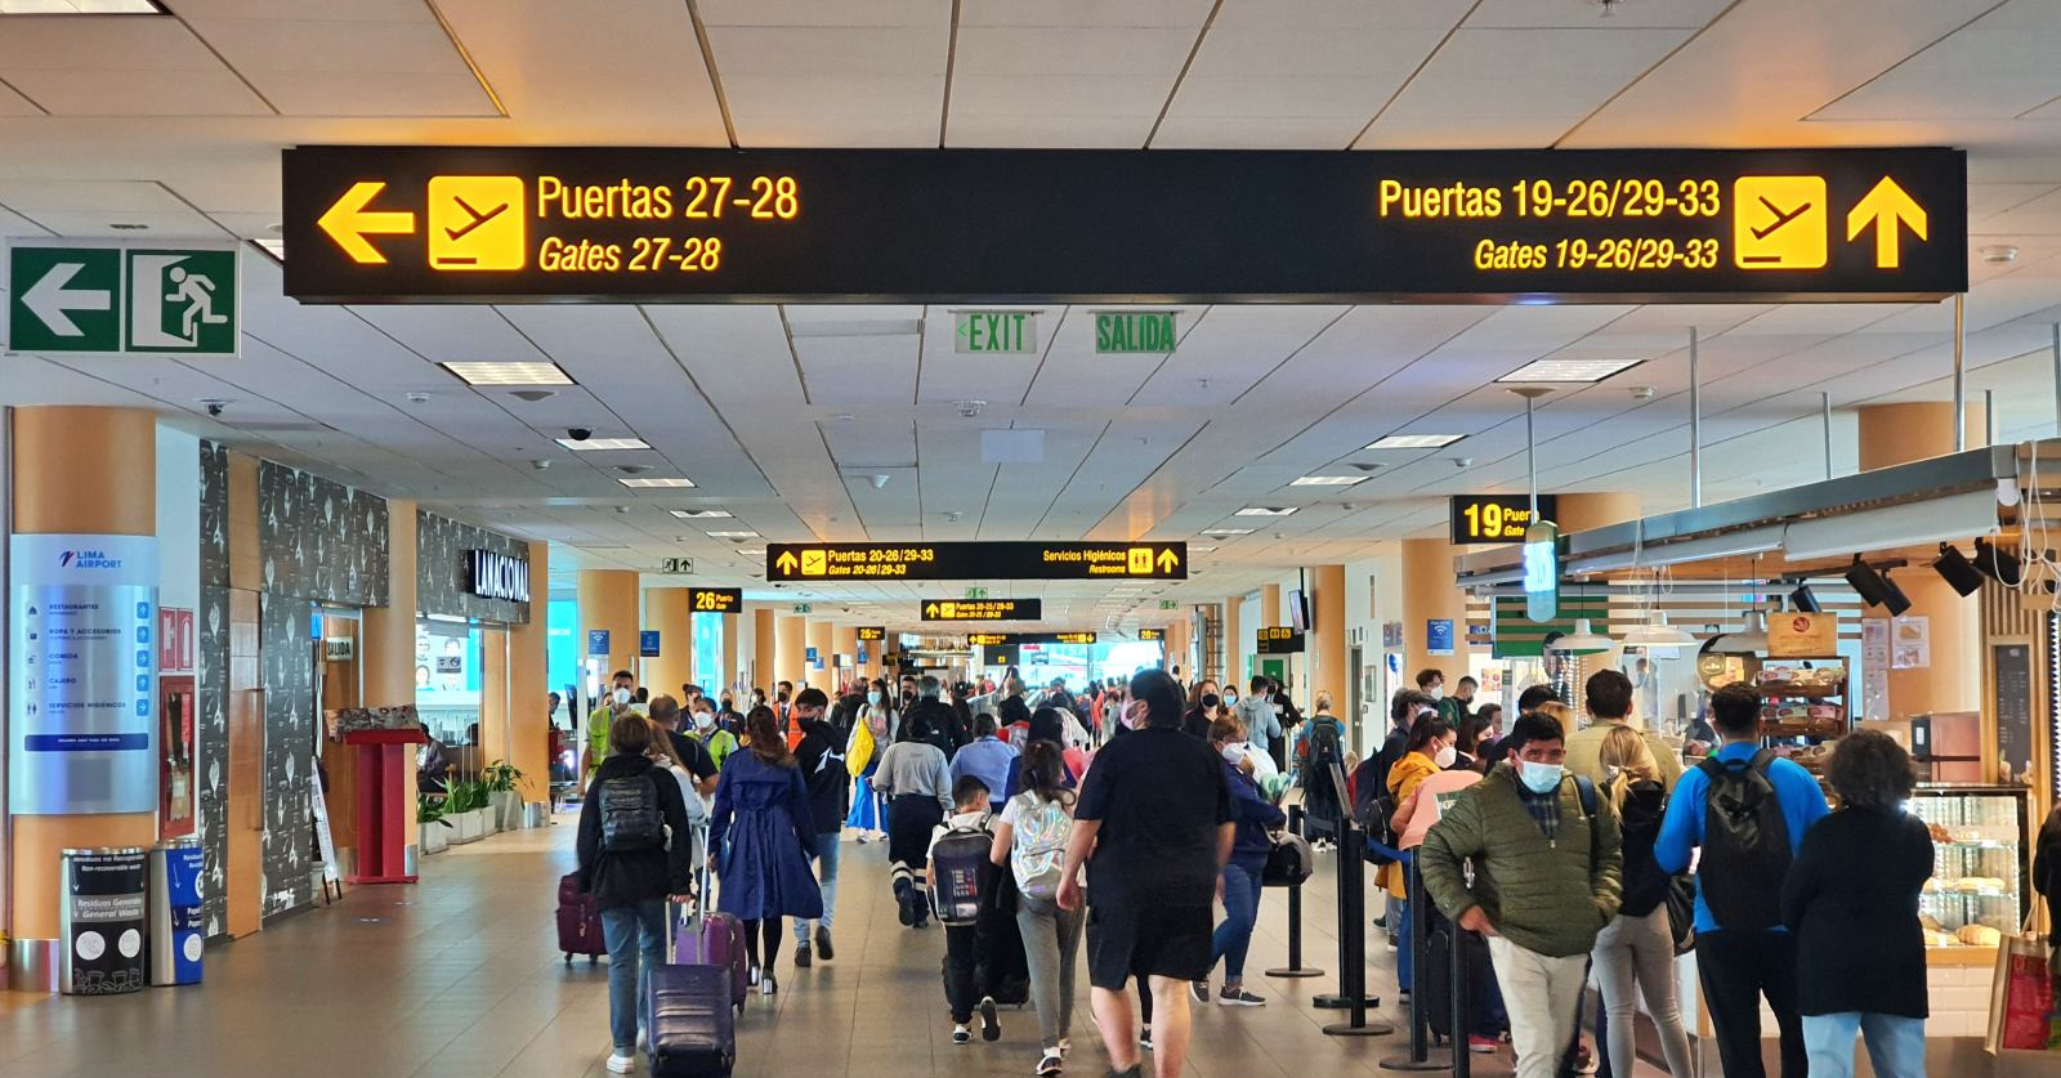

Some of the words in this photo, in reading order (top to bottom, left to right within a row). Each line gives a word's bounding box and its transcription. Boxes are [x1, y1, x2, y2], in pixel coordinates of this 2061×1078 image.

[537, 175, 673, 219] Puertas
[685, 176, 799, 219] 27-28
[1379, 179, 1503, 217] Puertas
[1511, 179, 1721, 218] 19-26/29-33
[538, 236, 622, 271] Gates
[628, 237, 722, 271] 27-28
[1473, 238, 1548, 270] Gates
[1555, 238, 1720, 271] 19-26/29-33
[969, 314, 1026, 351] EXIT
[1096, 314, 1176, 351] SALIDA
[1464, 503, 1502, 538] 19
[1504, 524, 1525, 537] Gate
[77, 550, 105, 559] LIMA
[828, 549, 867, 562] Puertas
[869, 549, 934, 562] 20-26/29-33
[1043, 549, 1082, 562] Servicios
[76, 559, 122, 568] AIRPORT
[828, 564, 851, 575] Gates
[852, 564, 907, 575] 20-26/29-33
[1089, 564, 1126, 574] Restrooms
[696, 592, 715, 610] 26
[327, 641, 351, 656] SALIDA
[78, 898, 111, 907] Residuos
[82, 910, 117, 918] General
